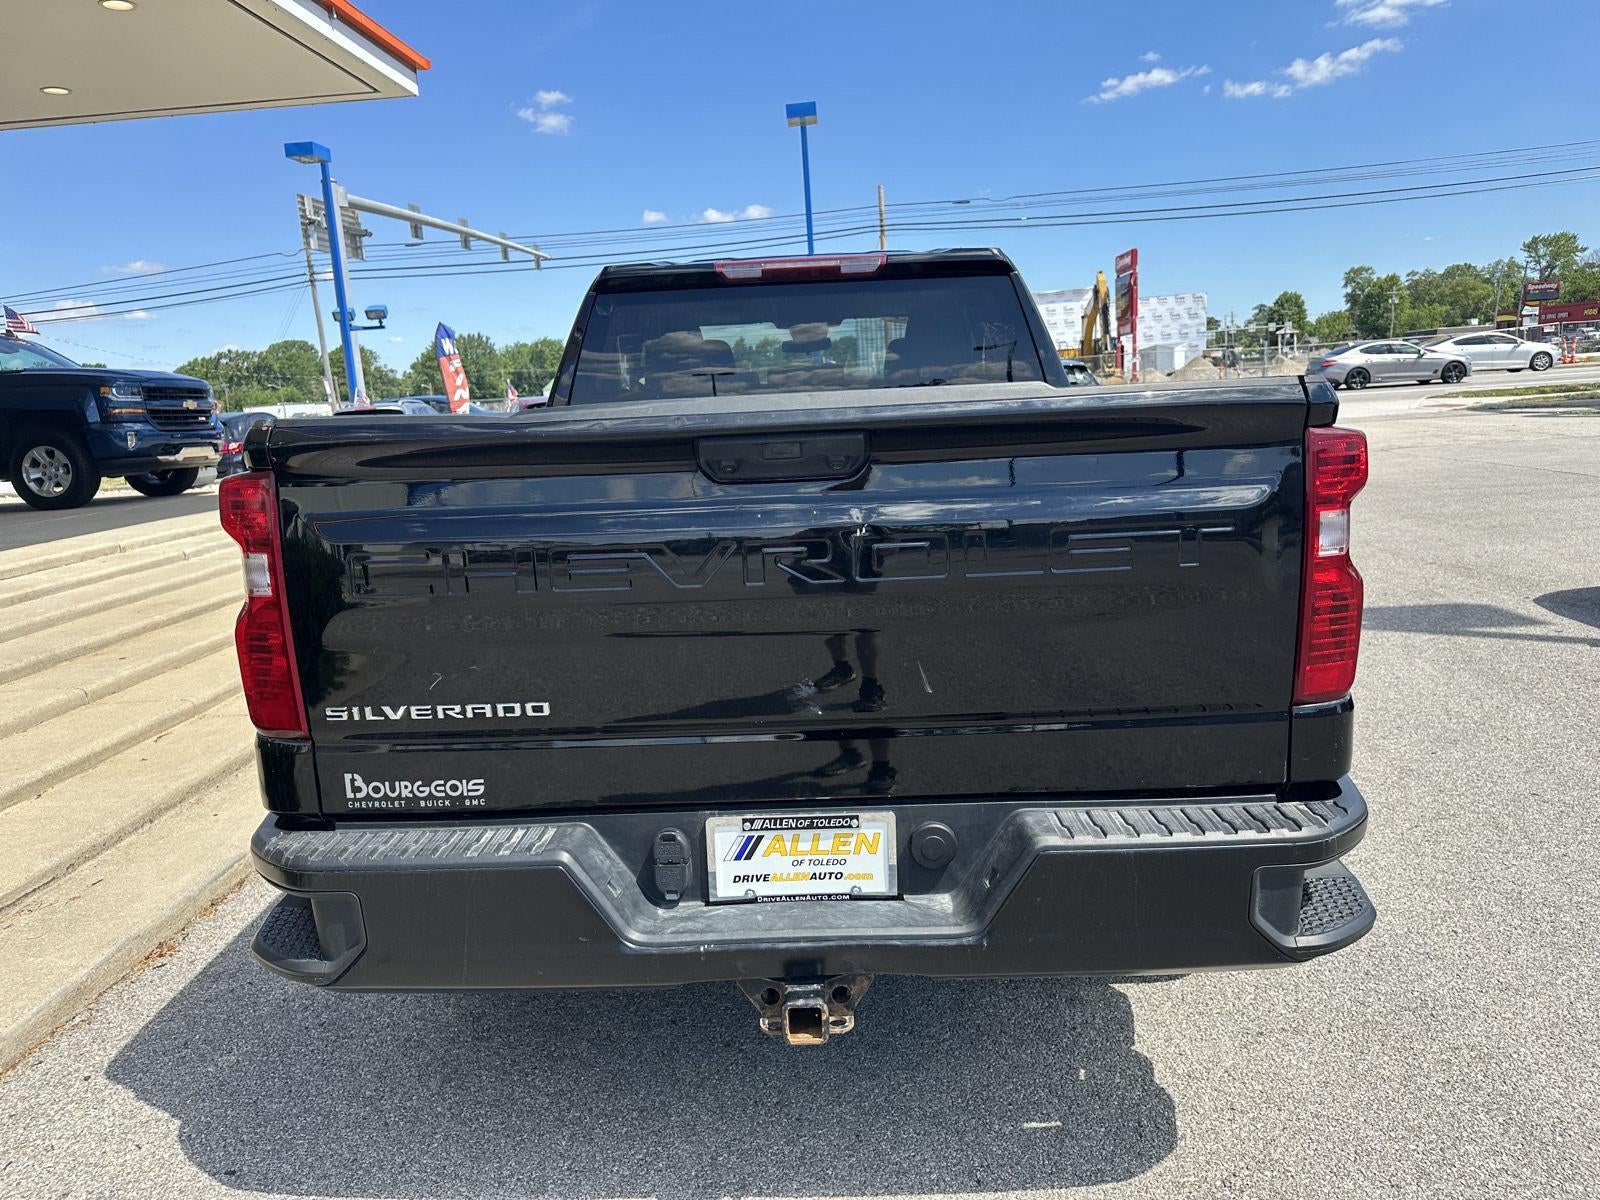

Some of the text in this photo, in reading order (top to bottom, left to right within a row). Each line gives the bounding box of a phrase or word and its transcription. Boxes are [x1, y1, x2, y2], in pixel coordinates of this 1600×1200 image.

[345, 521, 1235, 598] CHEVROLET
[325, 702, 550, 721] SILVERADO
[348, 798, 486, 809] CHEVROLET BUICK GMC
[763, 817, 851, 829] ALLEN OF TOLEDO
[762, 833, 880, 856] ALLEN
[791, 858, 847, 867] OF TOLEDO
